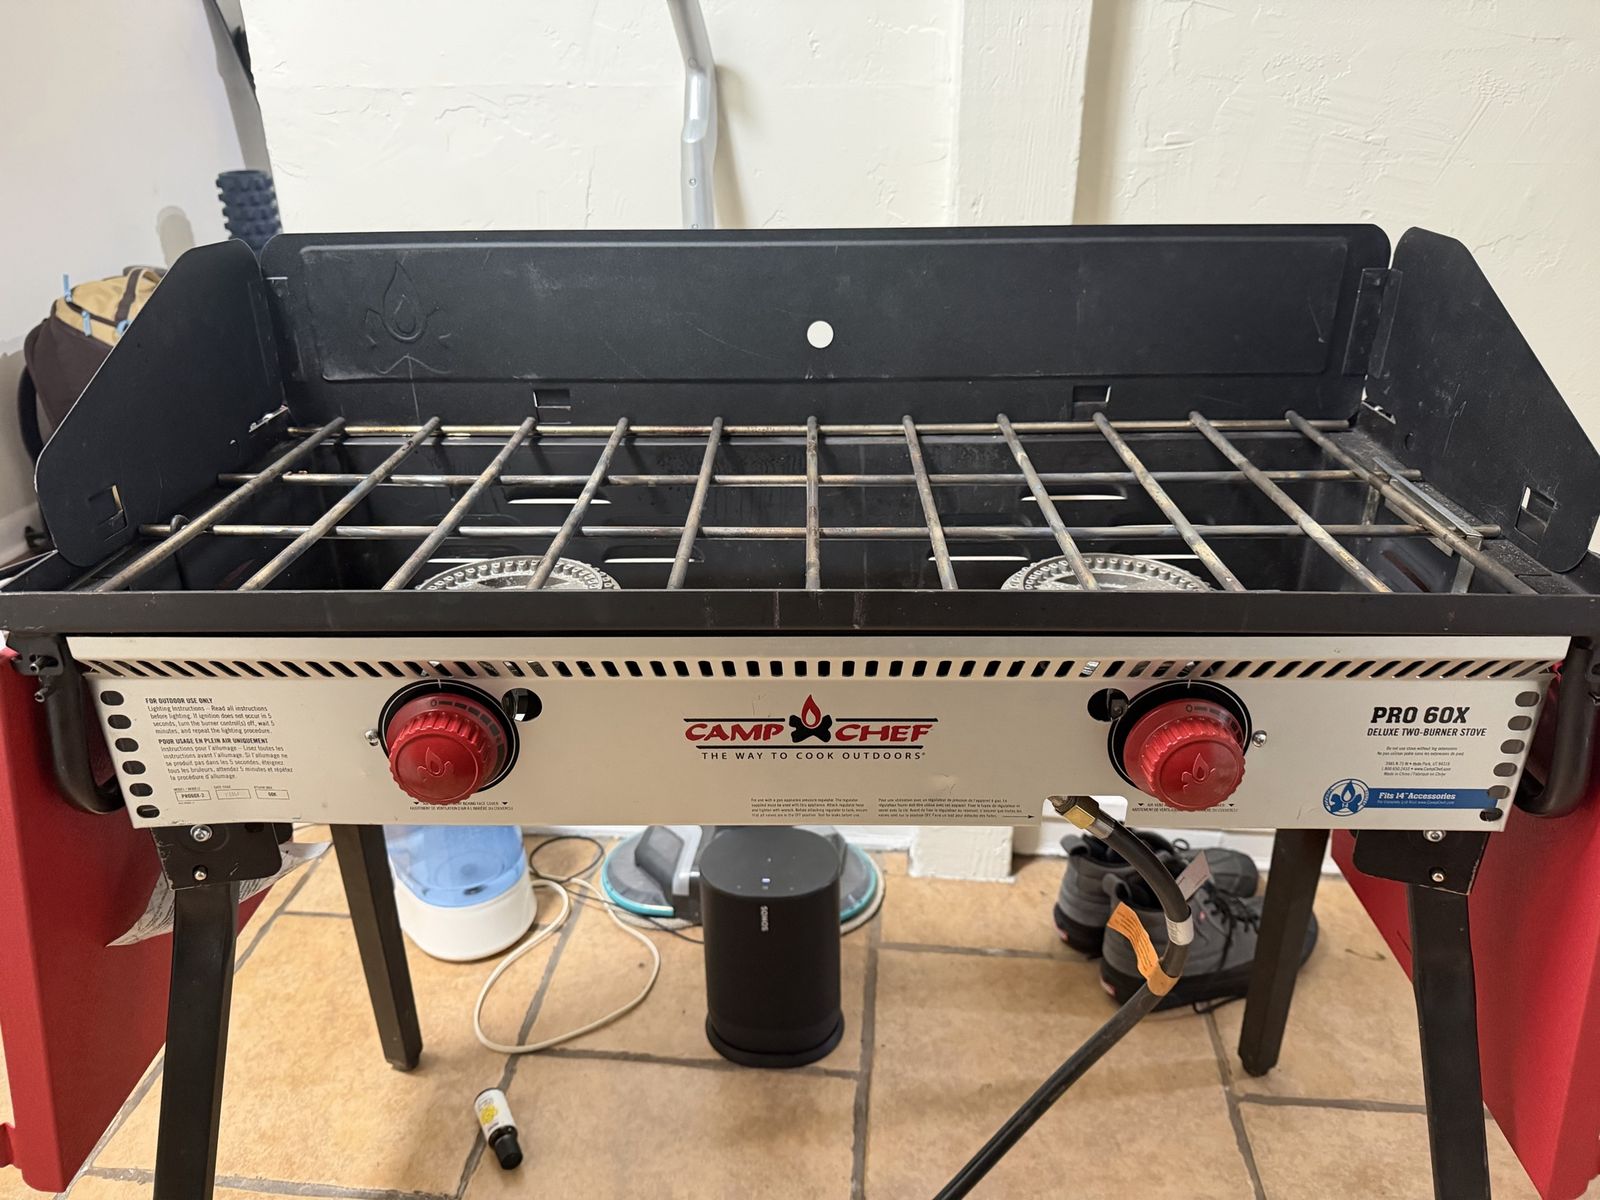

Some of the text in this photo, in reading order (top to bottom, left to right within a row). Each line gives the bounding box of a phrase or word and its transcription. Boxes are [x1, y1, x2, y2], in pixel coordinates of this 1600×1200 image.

[1370, 706, 1470, 724] PRO 60X
[685, 723, 933, 742] CAMP CHEF
[1367, 728, 1487, 736] DELUXE TWO-BURNER STOVE
[760, 906, 769, 932] SONOS
